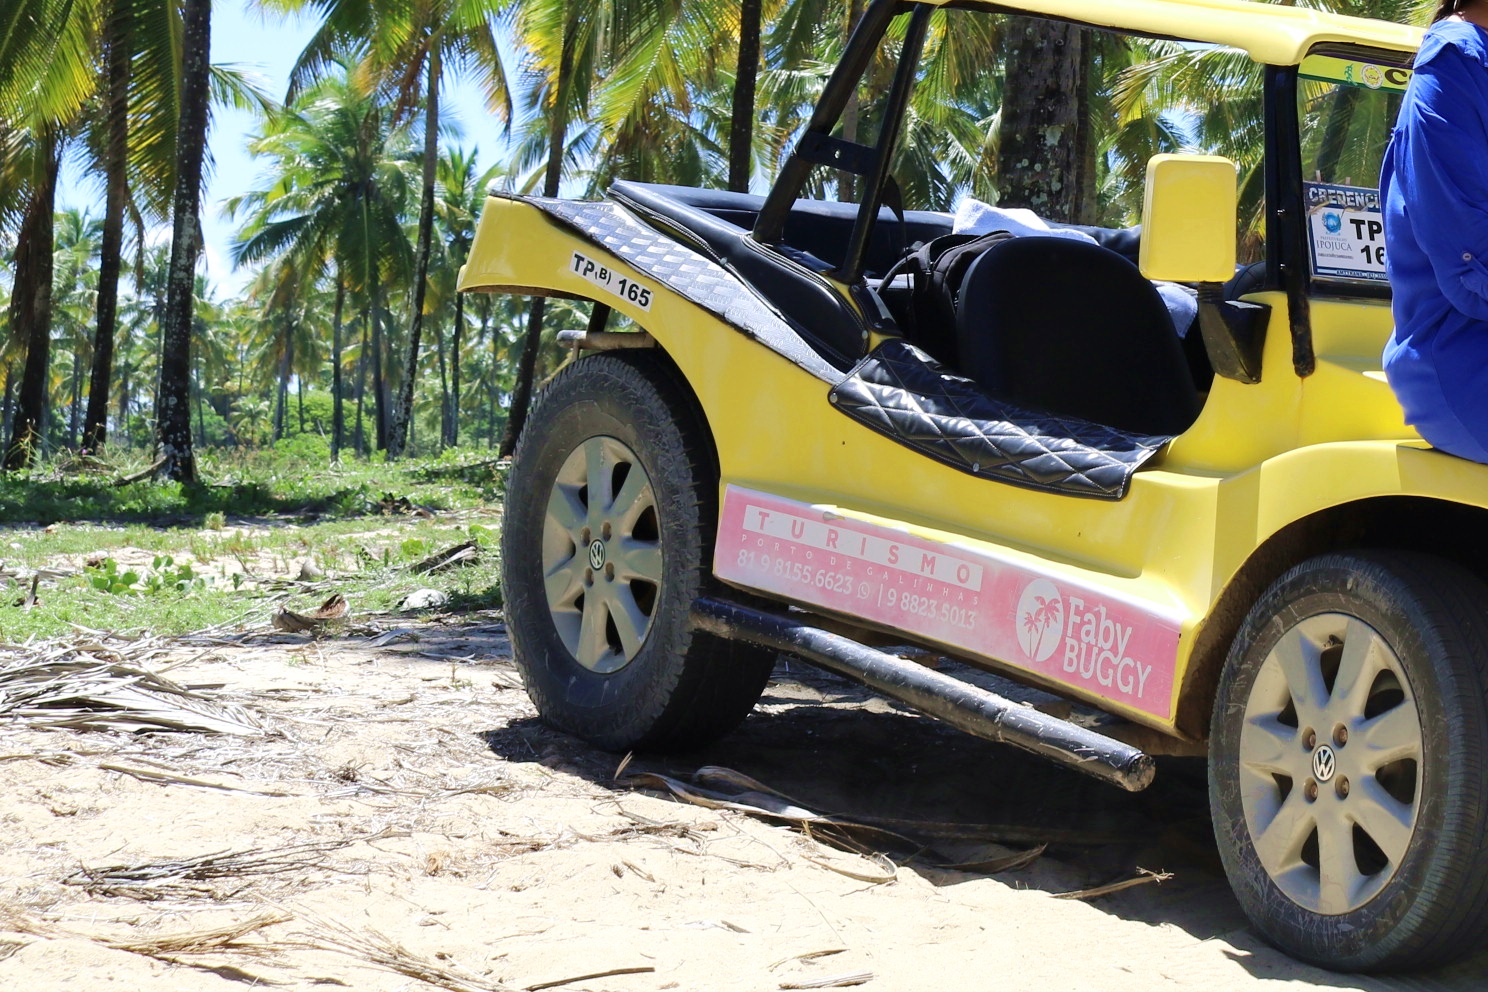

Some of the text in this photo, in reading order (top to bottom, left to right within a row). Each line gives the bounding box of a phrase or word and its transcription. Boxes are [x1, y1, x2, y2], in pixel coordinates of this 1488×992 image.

[1316, 239, 1353, 252] IPOJUCA
[1350, 218, 1383, 242] TP
[1361, 245, 1385, 266] 16
[618, 278, 651, 307] 165
[741, 534, 978, 606] PORTO DE GALINHAS
[758, 511, 970, 585] TURISMO
[737, 549, 755, 569] 81
[760, 554, 770, 572] 9
[774, 558, 854, 595] 8155.6623
[886, 588, 898, 607] 9
[1067, 596, 1132, 665] Faby
[1063, 637, 1152, 698] BUGGY
